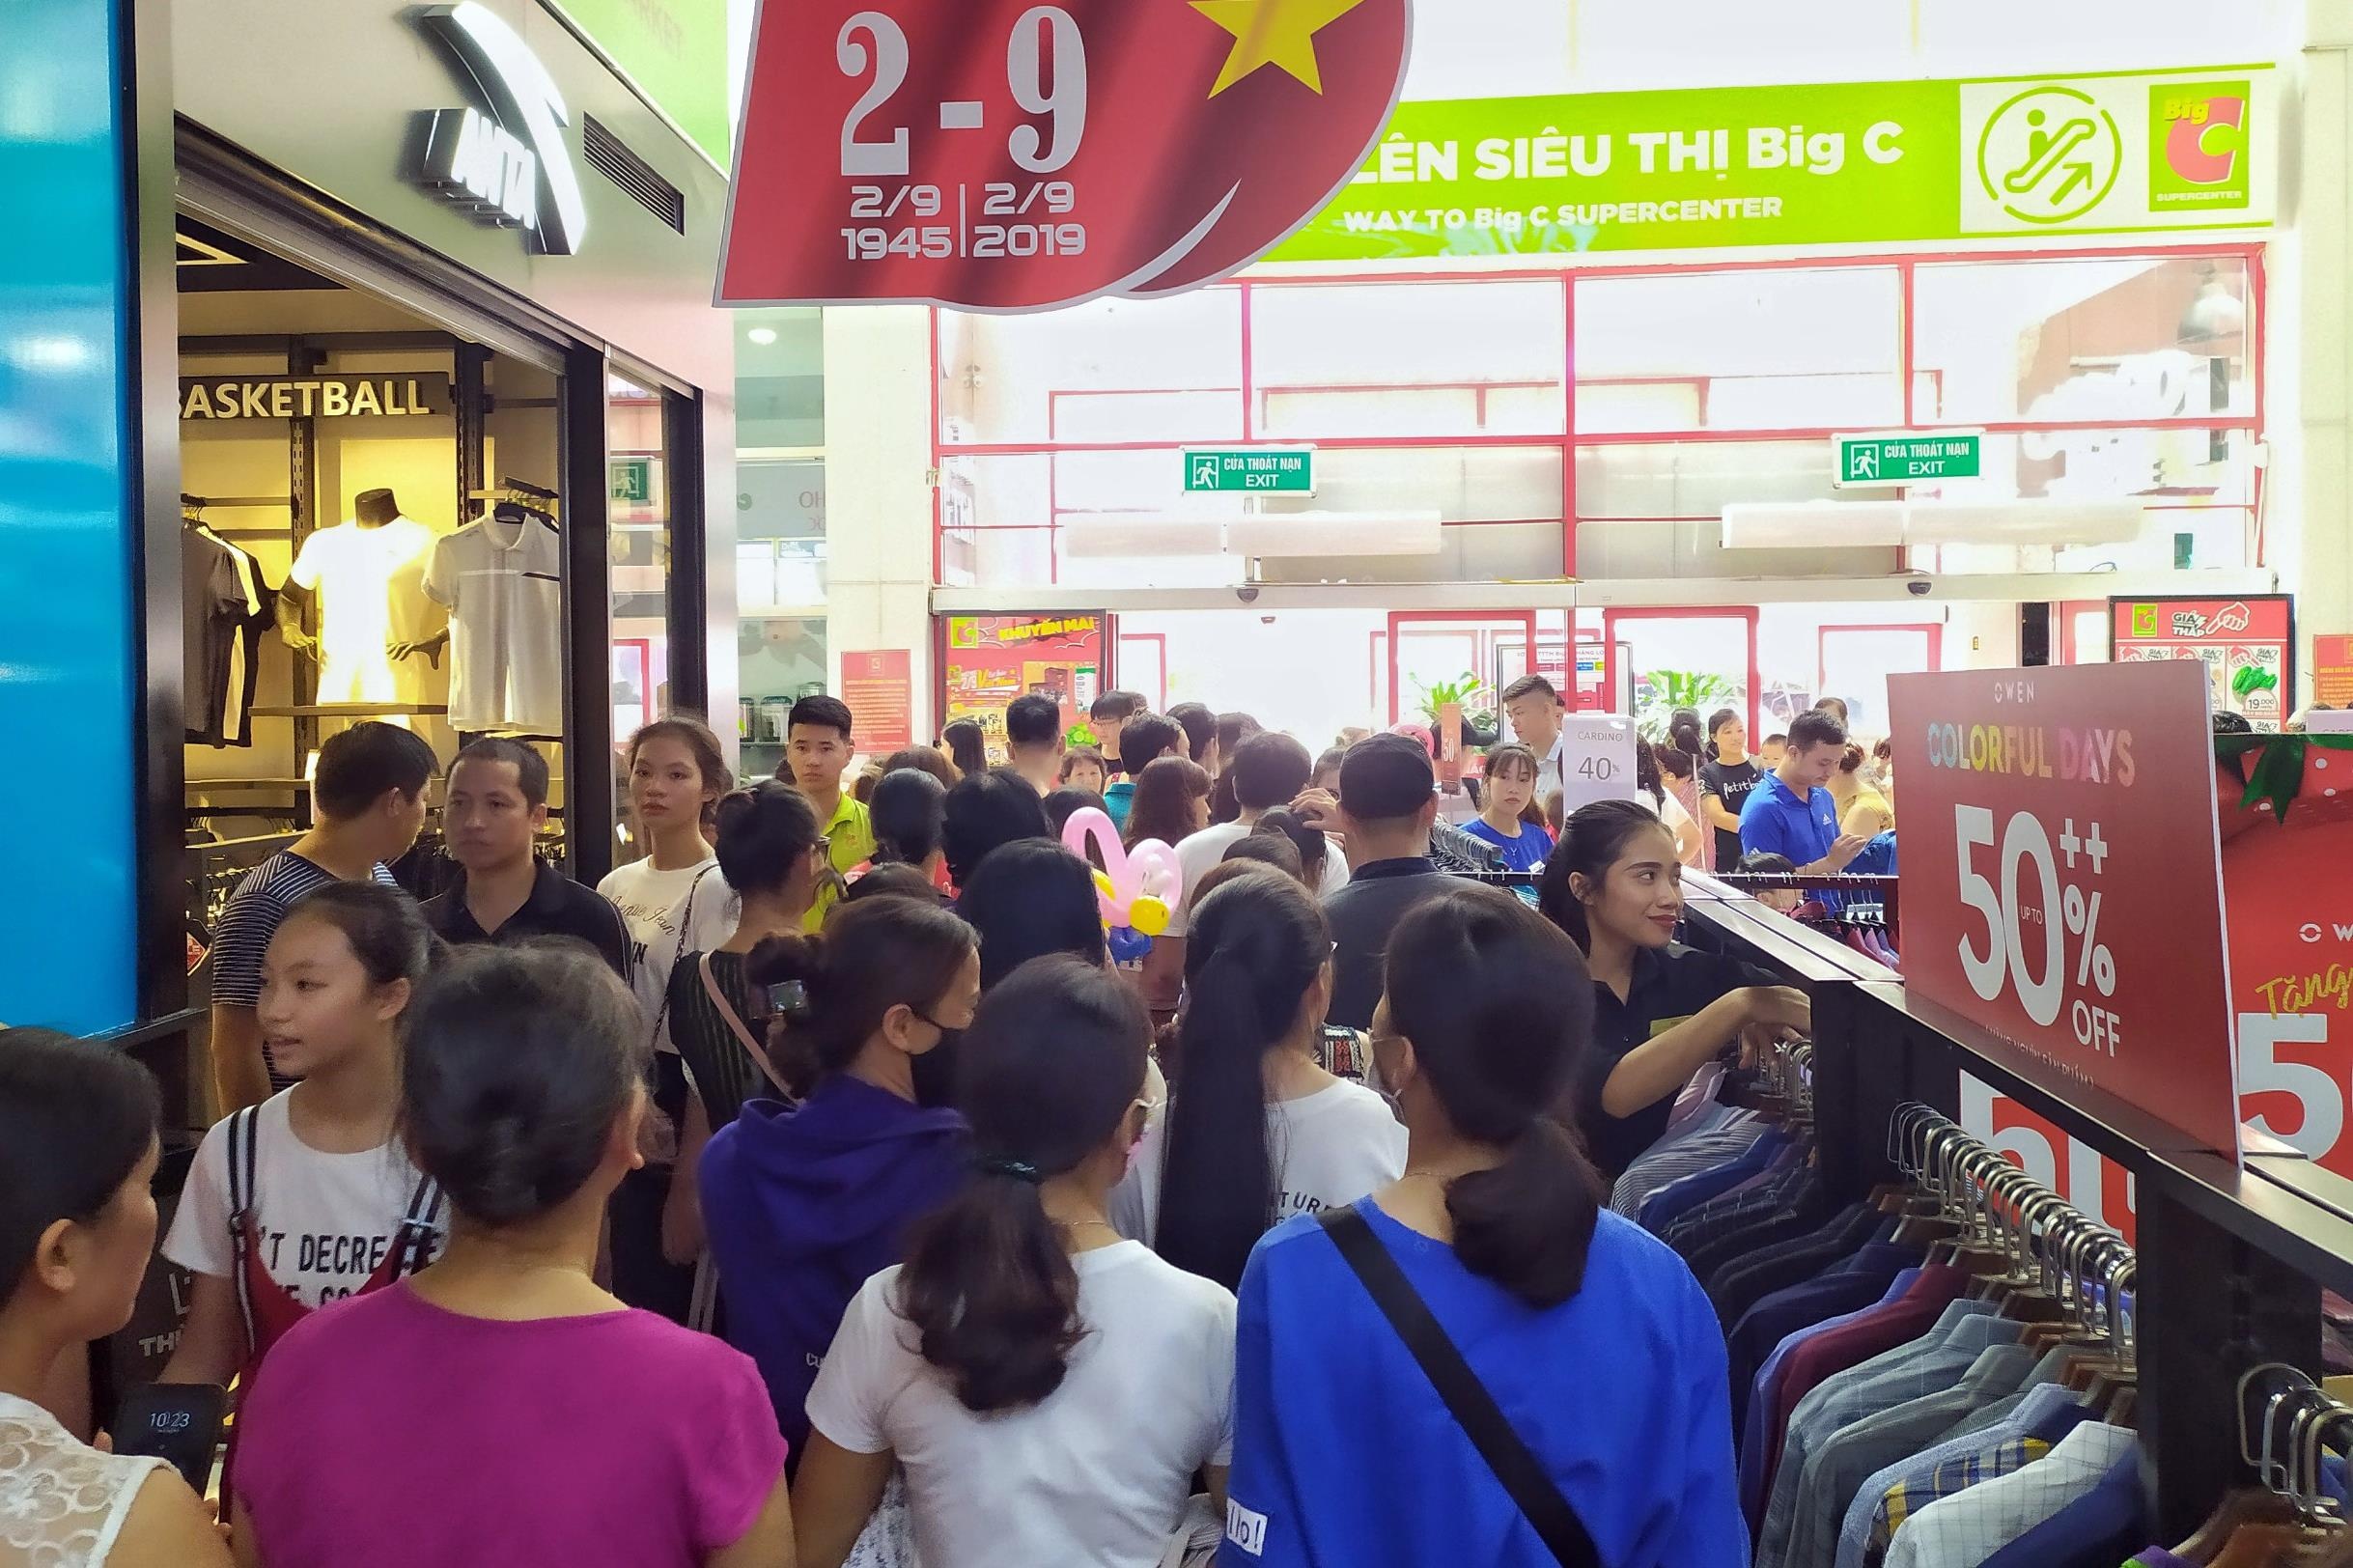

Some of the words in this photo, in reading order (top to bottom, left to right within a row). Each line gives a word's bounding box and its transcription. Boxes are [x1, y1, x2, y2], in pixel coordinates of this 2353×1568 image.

[2163, 98, 2210, 126] Big
[1474, 126, 1611, 182] SIÊU
[1628, 128, 1729, 182] THỊ
[1748, 122, 1846, 175] Big
[1863, 121, 1905, 164] C
[850, 184, 941, 217] 2/9
[983, 182, 1076, 214] 2/9
[2155, 190, 2243, 203] SUPERCENTER
[1343, 210, 1417, 233] WAY
[1427, 208, 1468, 230] TO
[1474, 206, 1522, 233] Big
[1529, 205, 1550, 227] C
[1557, 196, 1783, 227] SUPERCENTER
[841, 224, 953, 260] 1945
[973, 223, 1086, 258] 2019
[179, 379, 430, 419] ASKETBALL
[1246, 473, 1280, 488] EXIT
[1908, 460, 1947, 475] EXIT
[1994, 681, 2035, 704] OWEN
[1578, 731, 1623, 742] CARDINO
[1926, 721, 2053, 778] COLORFUL
[2059, 726, 2136, 788] DAYS
[1954, 803, 2064, 1027] 50
[2020, 905, 2031, 920] UP
[2031, 908, 2043, 925] TO
[2072, 998, 2122, 1058] OFF
